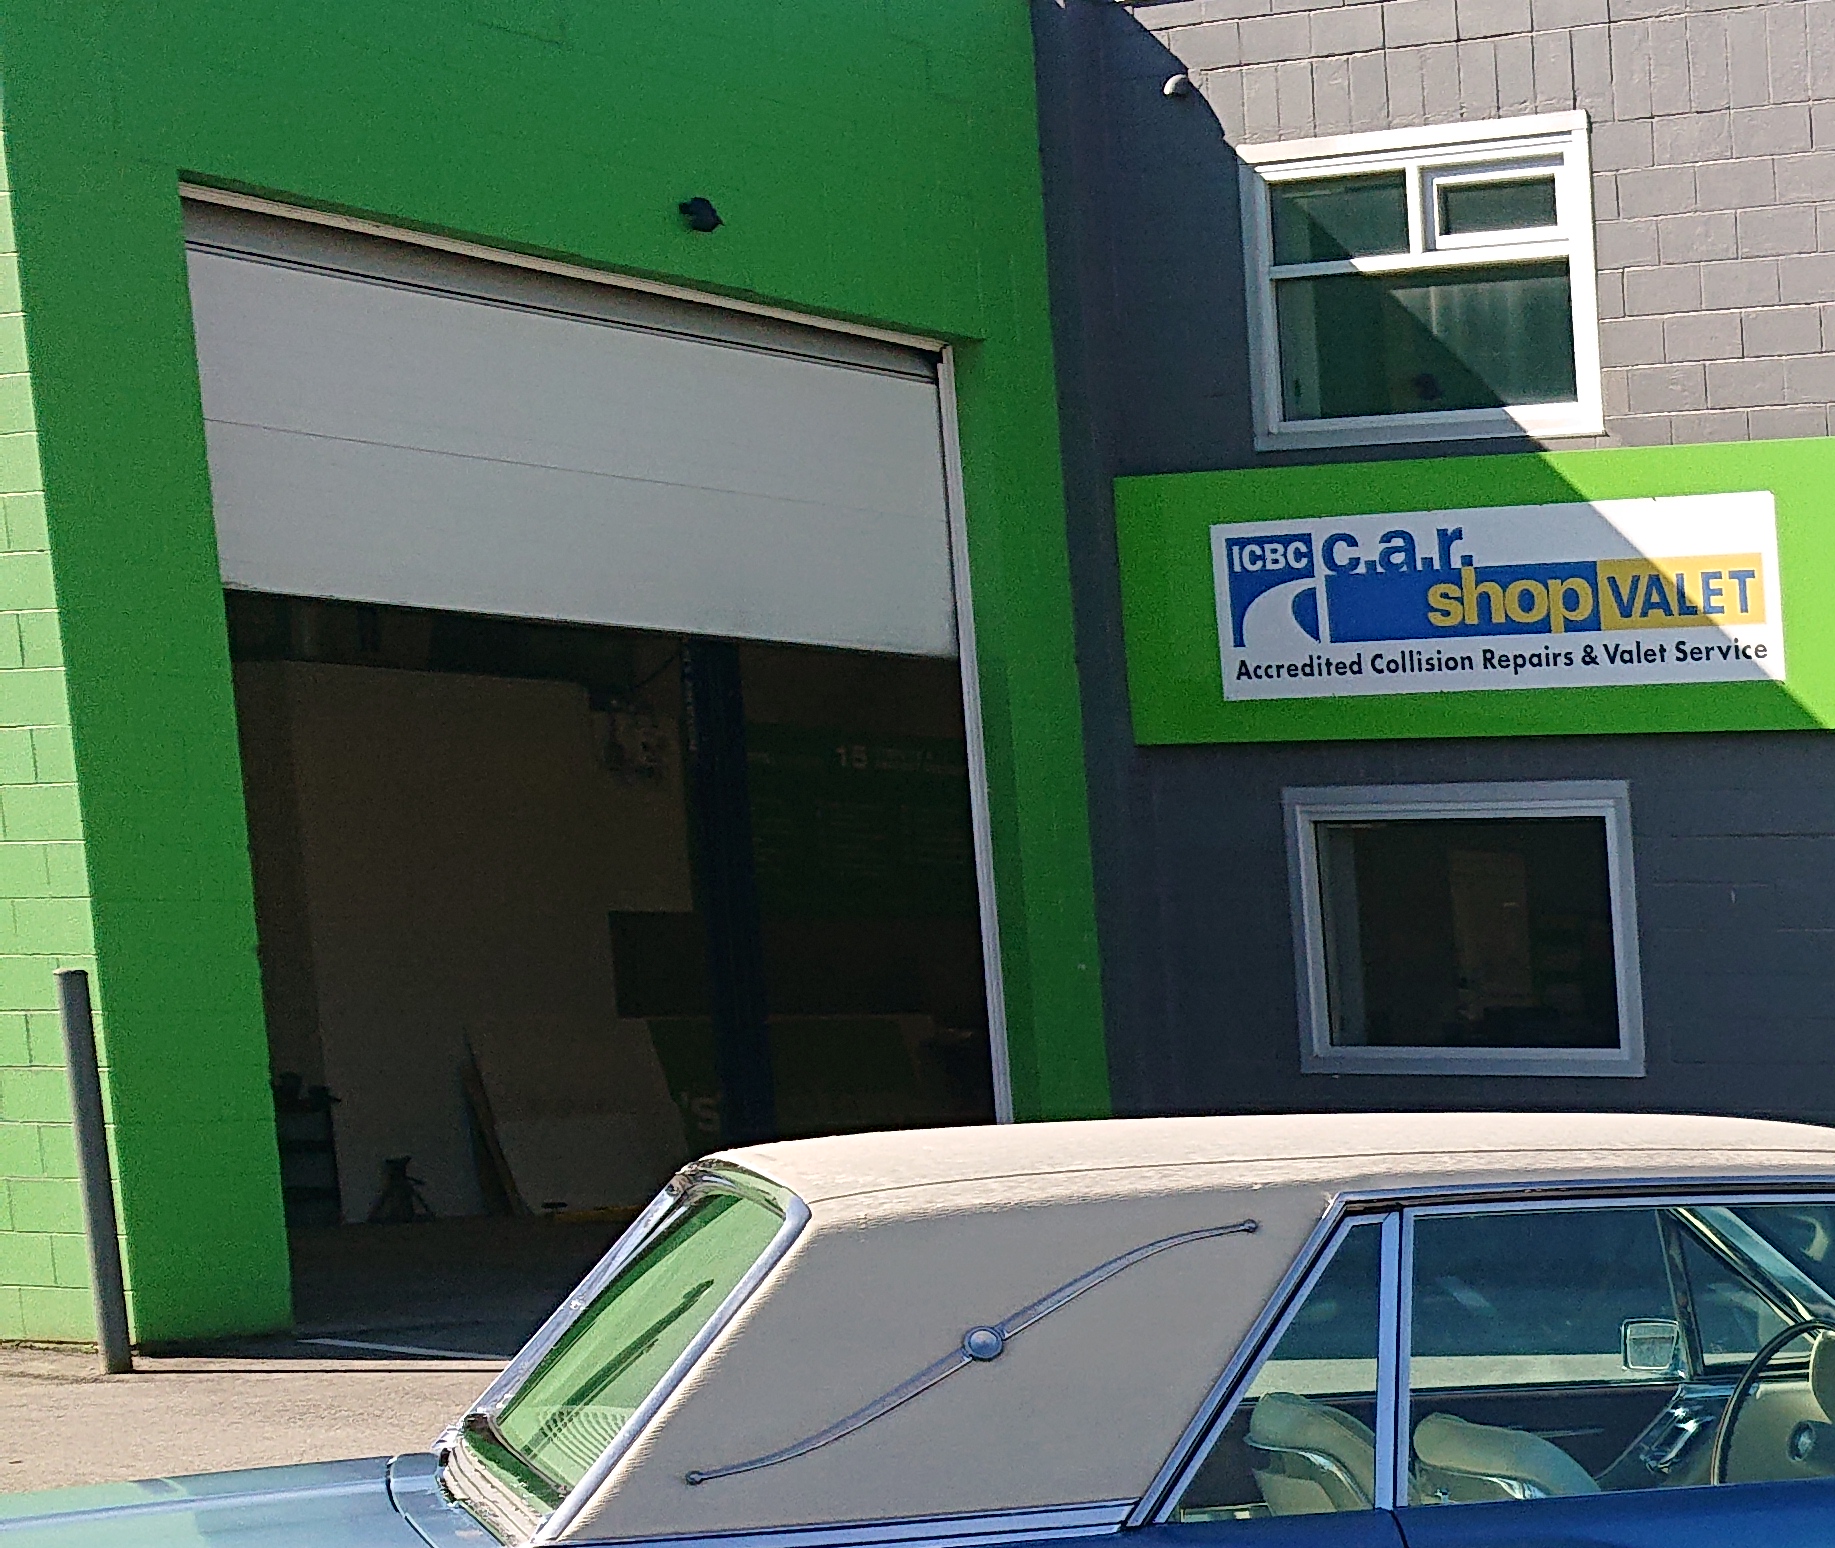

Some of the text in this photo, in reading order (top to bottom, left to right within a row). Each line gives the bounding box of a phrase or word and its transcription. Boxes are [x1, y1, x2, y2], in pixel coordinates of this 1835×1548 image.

[1230, 540, 1309, 574] ICBC
[1427, 566, 1756, 634] shop VALET
[1236, 637, 1768, 681] Accredited Collision Repairs & Valet Service
